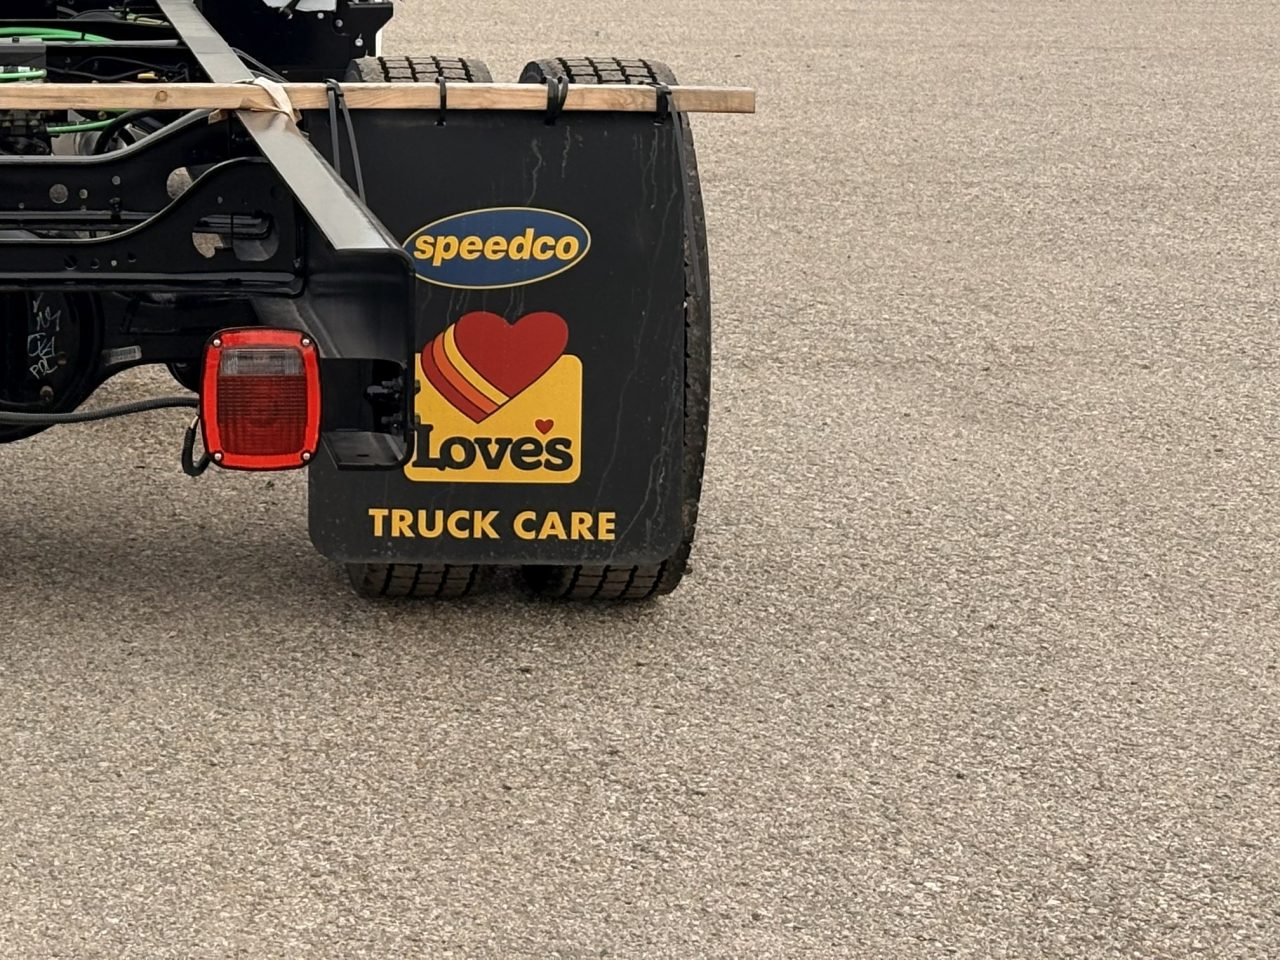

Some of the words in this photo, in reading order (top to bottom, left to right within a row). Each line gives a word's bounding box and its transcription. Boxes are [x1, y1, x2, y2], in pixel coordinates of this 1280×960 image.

[413, 228, 580, 267] speedco
[368, 508, 500, 539] TRUCK
[513, 511, 617, 541] CARE
